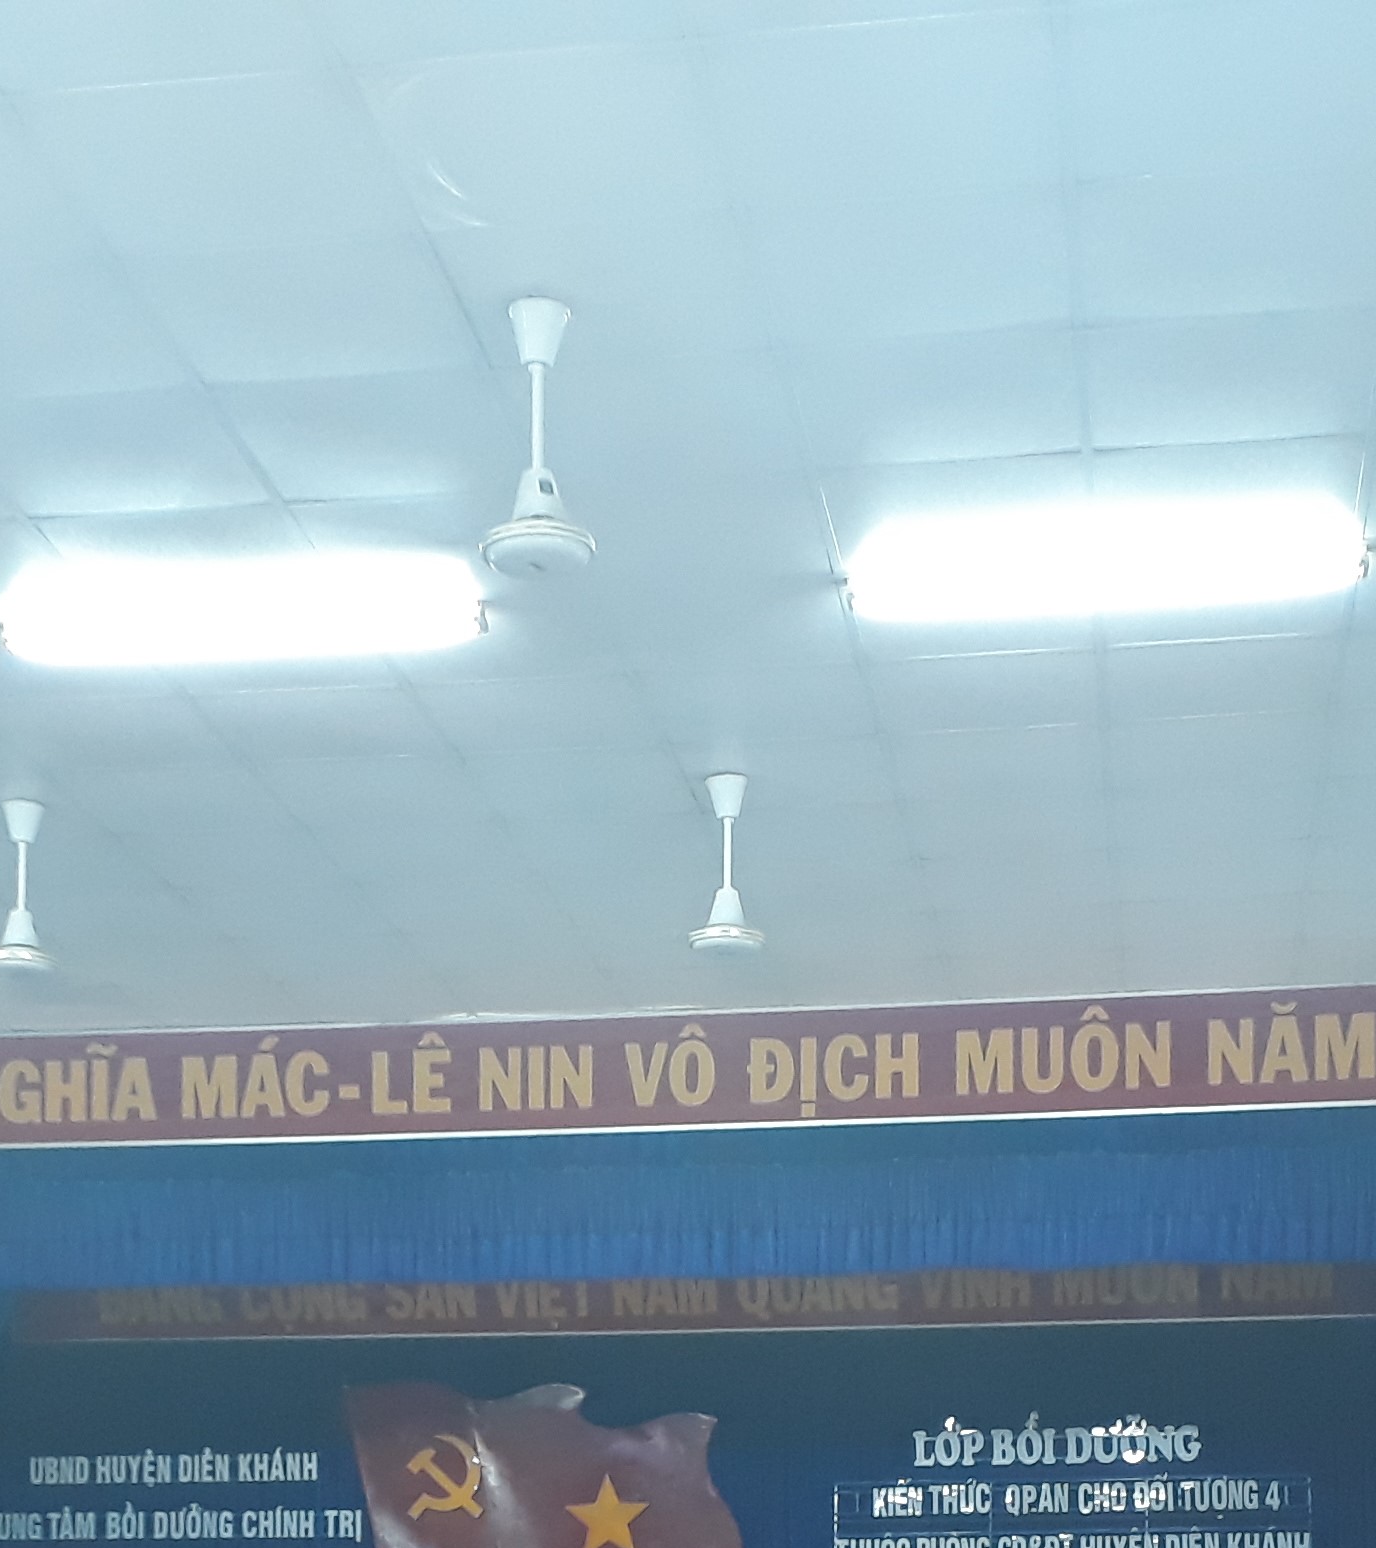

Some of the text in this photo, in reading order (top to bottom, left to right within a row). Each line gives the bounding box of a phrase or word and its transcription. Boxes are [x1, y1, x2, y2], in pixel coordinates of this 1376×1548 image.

[478, 1044, 593, 1111] NIN
[625, 1023, 716, 1107] VÔ
[746, 1031, 919, 1118] ĐỊCH
[955, 1006, 1172, 1095] MUÔN
[1207, 1002, 1376, 1084] NĂM
[912, 1415, 984, 1467] LỚP
[1064, 1414, 1202, 1464] DƯỠNG
[30, 1455, 89, 1485] UBND
[95, 1448, 171, 1487] HUYỆN
[238, 1446, 318, 1482] KHÁNH
[872, 1477, 923, 1518] KIẾN
[928, 1477, 991, 1515] THỨC
[1078, 1481, 1127, 1514] CHO
[1180, 1476, 1259, 1520] TƯỢNG
[1265, 1480, 1280, 1511] 4
[46, 1506, 96, 1540] TÂM
[105, 1502, 145, 1540] BỒI
[153, 1502, 234, 1540] DƯỠNG
[241, 1506, 314, 1538] CHÍNH
[324, 1508, 362, 1543] TRỊ
